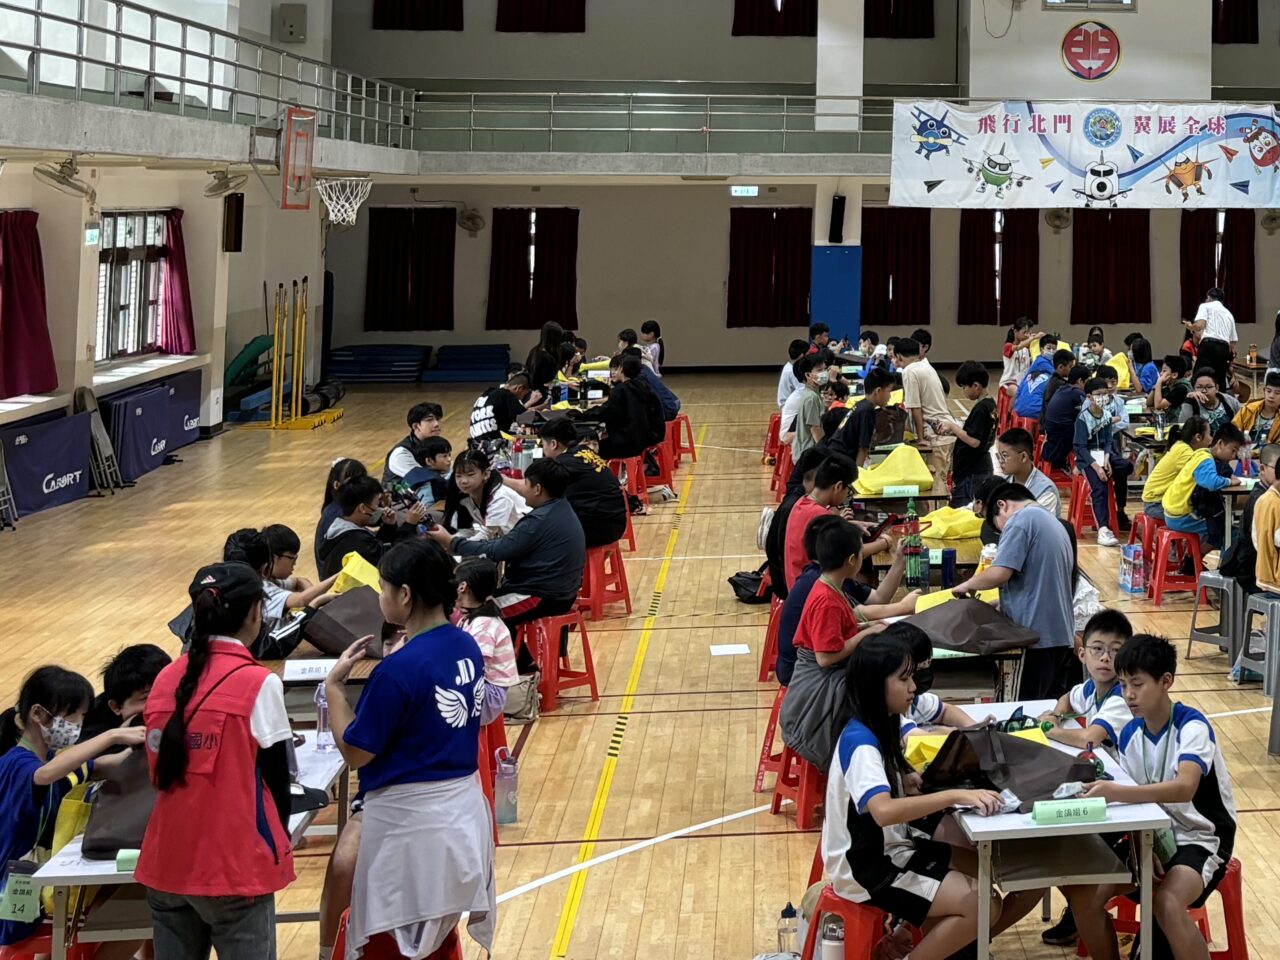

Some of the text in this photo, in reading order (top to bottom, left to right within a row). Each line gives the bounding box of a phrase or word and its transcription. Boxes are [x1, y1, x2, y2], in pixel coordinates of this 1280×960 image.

[976, 113, 1073, 135] 飛行北門
[1133, 114, 1227, 136] 翼展全球
[1082, 807, 1088, 816] 6
[11, 904, 25, 914] 14
